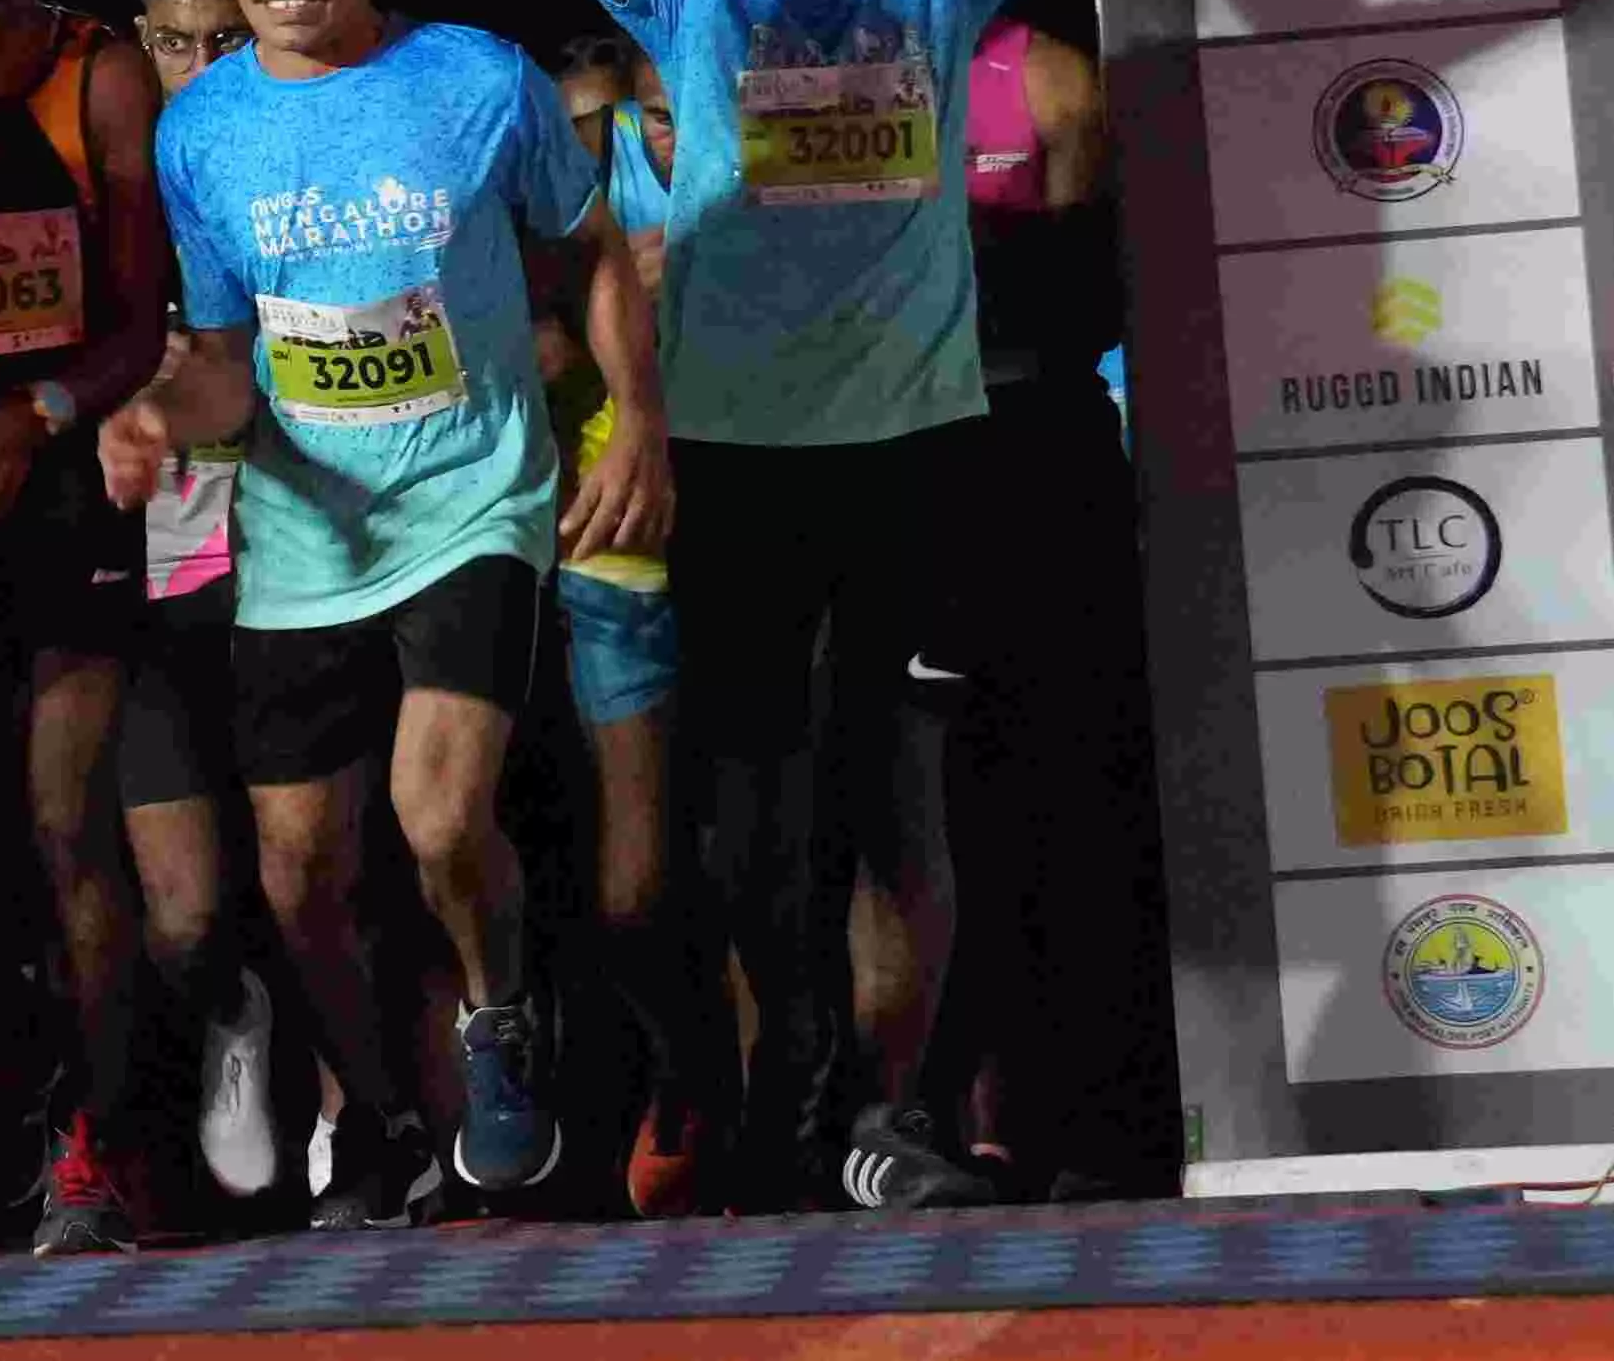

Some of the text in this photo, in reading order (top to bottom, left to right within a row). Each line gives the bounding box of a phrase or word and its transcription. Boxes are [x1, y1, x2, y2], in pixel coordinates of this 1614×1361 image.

[788, 120, 913, 165] 32001
[308, 341, 436, 391] 32091
[1281, 359, 1544, 413] RUGGD INDIAN
[1377, 514, 1468, 551] TLC
[1361, 690, 1519, 748] JOOS
[1368, 742, 1531, 796] BOTAL
